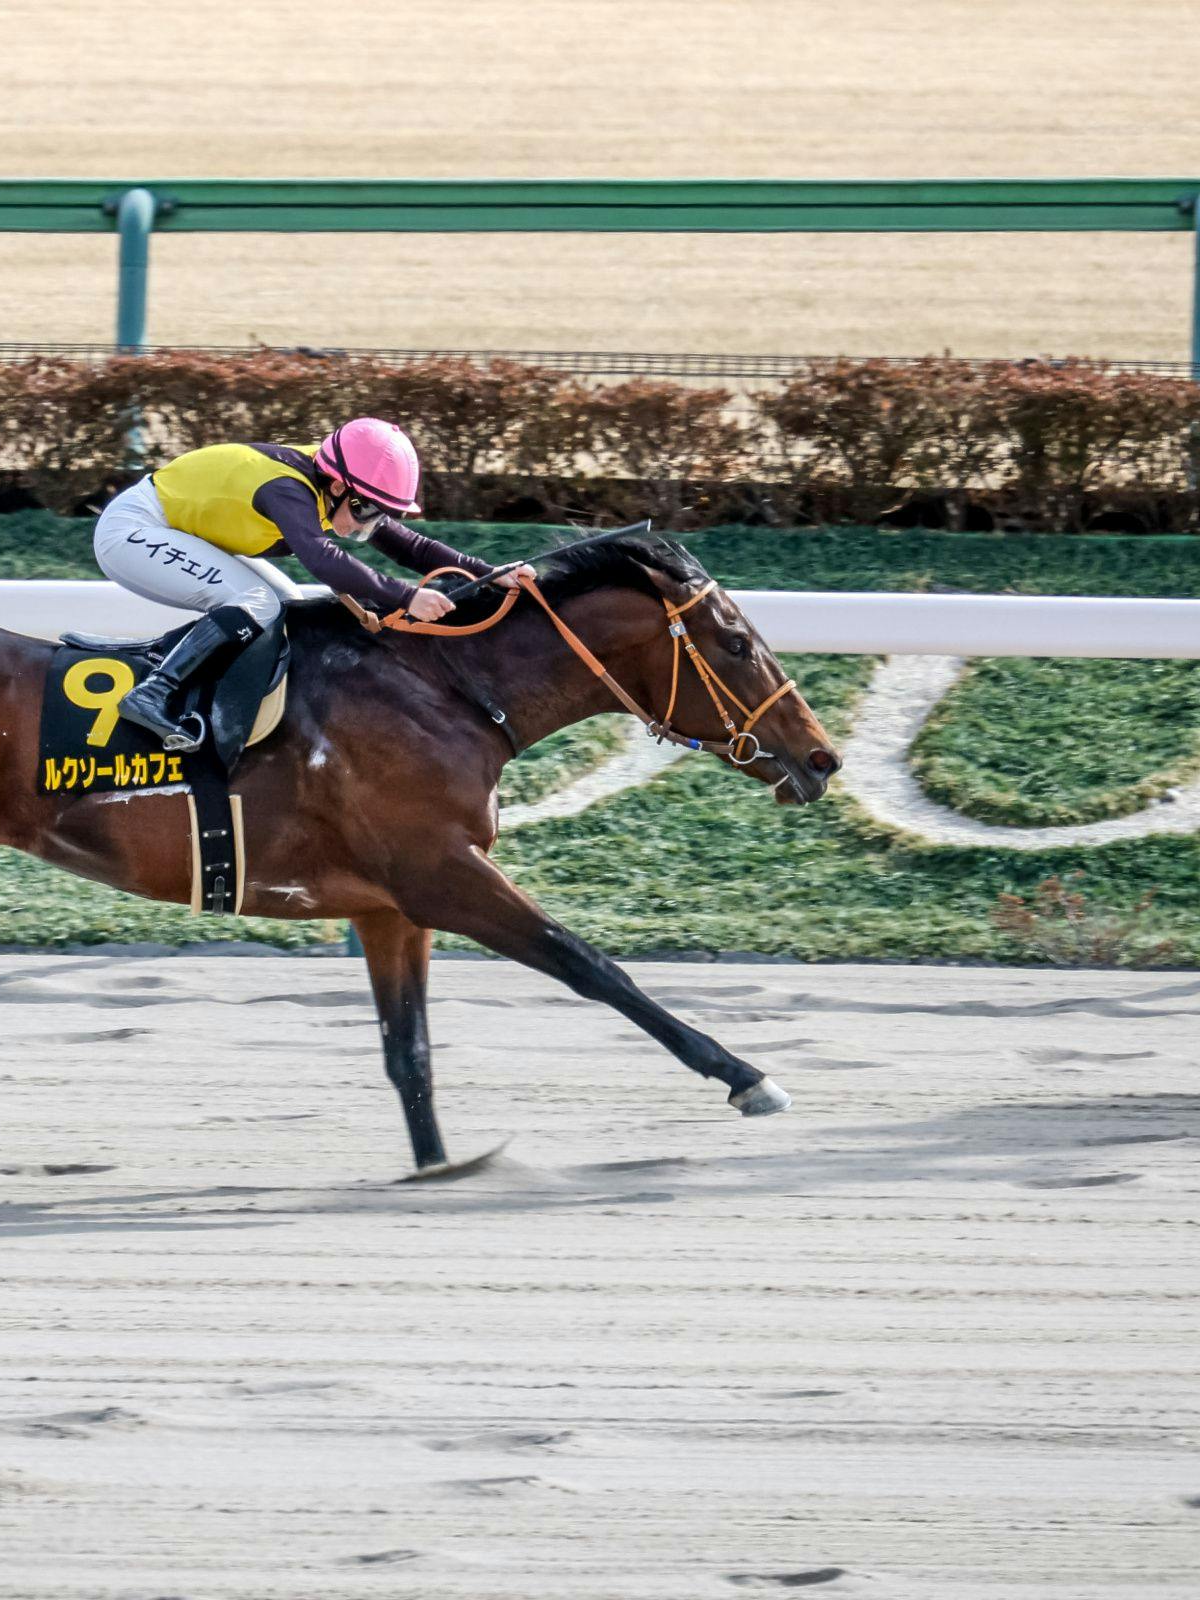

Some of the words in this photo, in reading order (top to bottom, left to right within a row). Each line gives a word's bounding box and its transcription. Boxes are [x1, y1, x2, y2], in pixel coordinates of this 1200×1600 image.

[127, 529, 222, 584] レイチェル
[63, 658, 135, 748] 9
[44, 752, 183, 790] ルクソールカフェ
